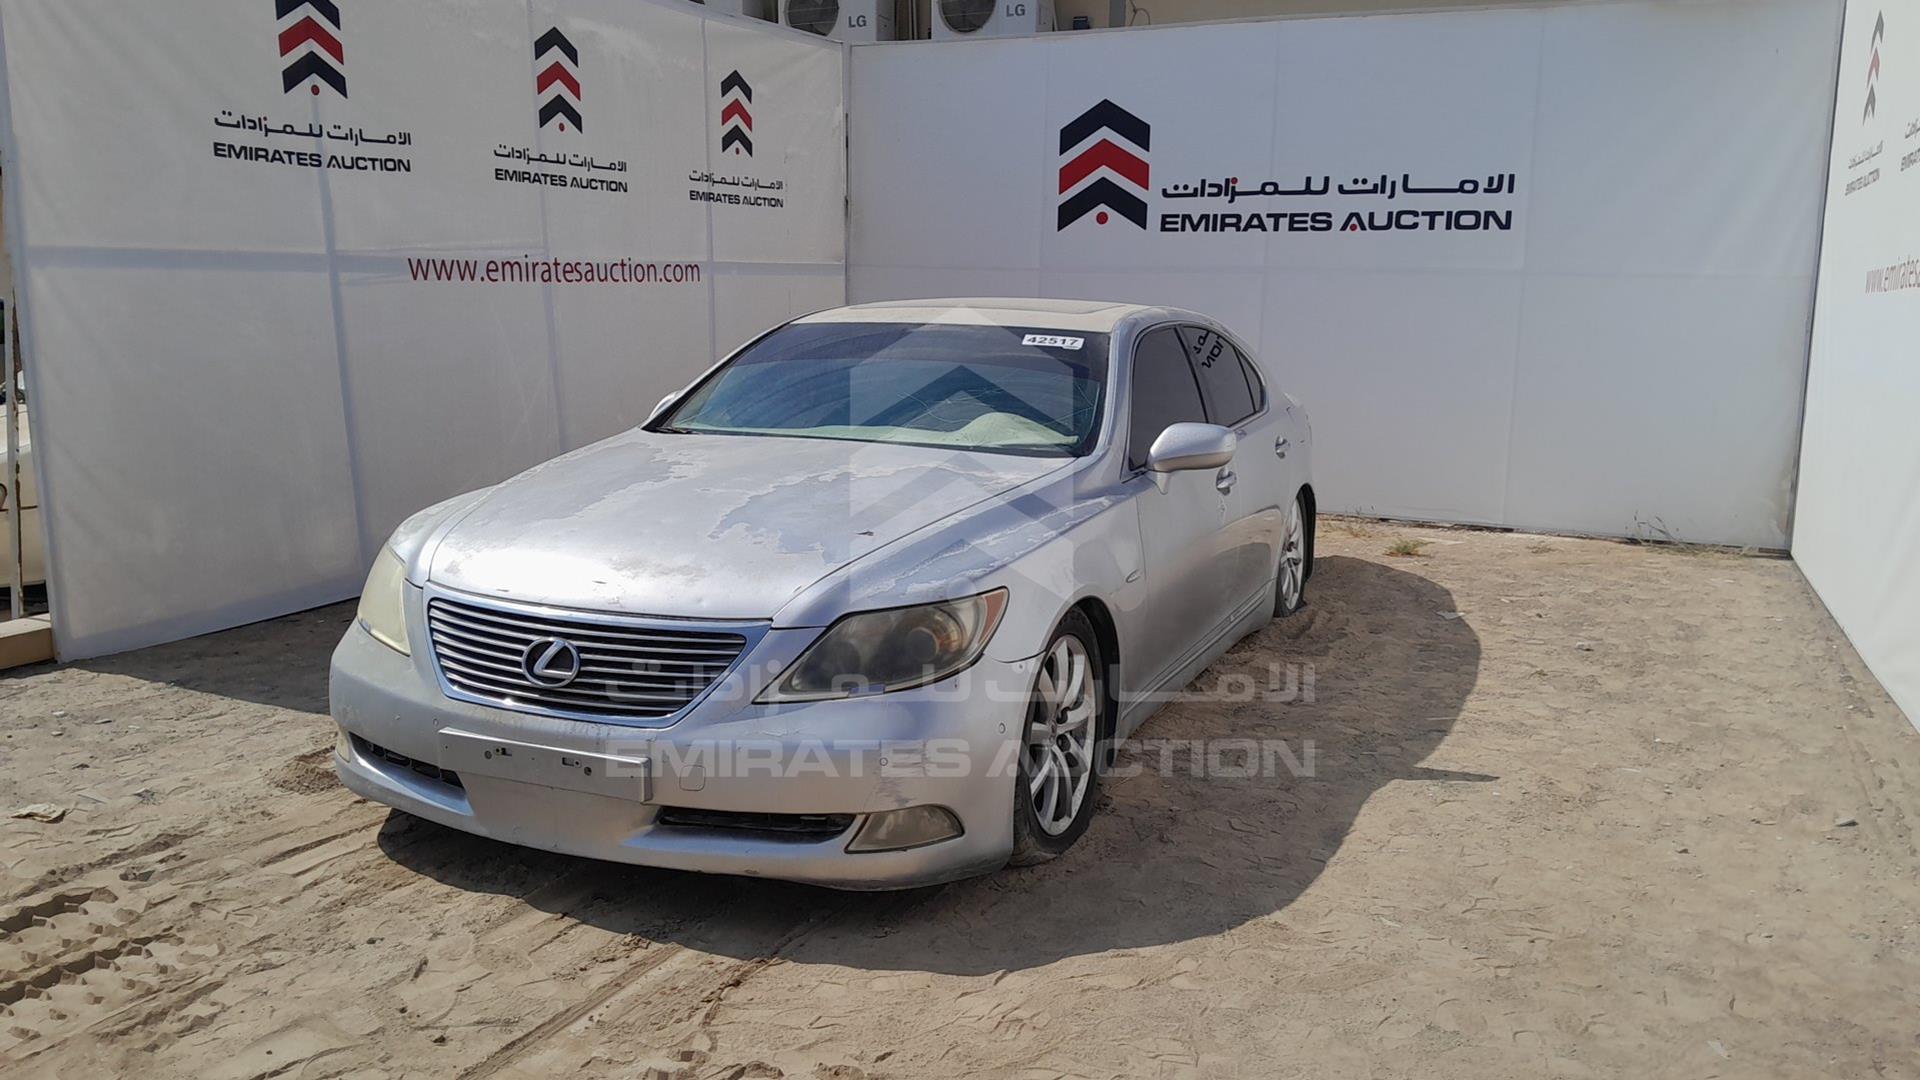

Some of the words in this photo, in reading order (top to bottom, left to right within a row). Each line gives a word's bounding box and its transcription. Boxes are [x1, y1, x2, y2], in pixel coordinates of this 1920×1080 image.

[847, 15, 868, 29] LG
[1005, 4, 1027, 18] LG
[212, 141, 323, 168] EMIRATES
[326, 154, 412, 173] AUCTION
[494, 168, 568, 188] EMIRATES
[569, 176, 628, 193] AUCTION
[688, 189, 741, 205] EMIRATES
[741, 195, 784, 209] AUCTION
[1159, 212, 1333, 233] EMIRATES
[1339, 209, 1514, 232] AUCTION
[407, 253, 701, 284] www.emiratesauction.com
[1026, 336, 1080, 347] 42517
